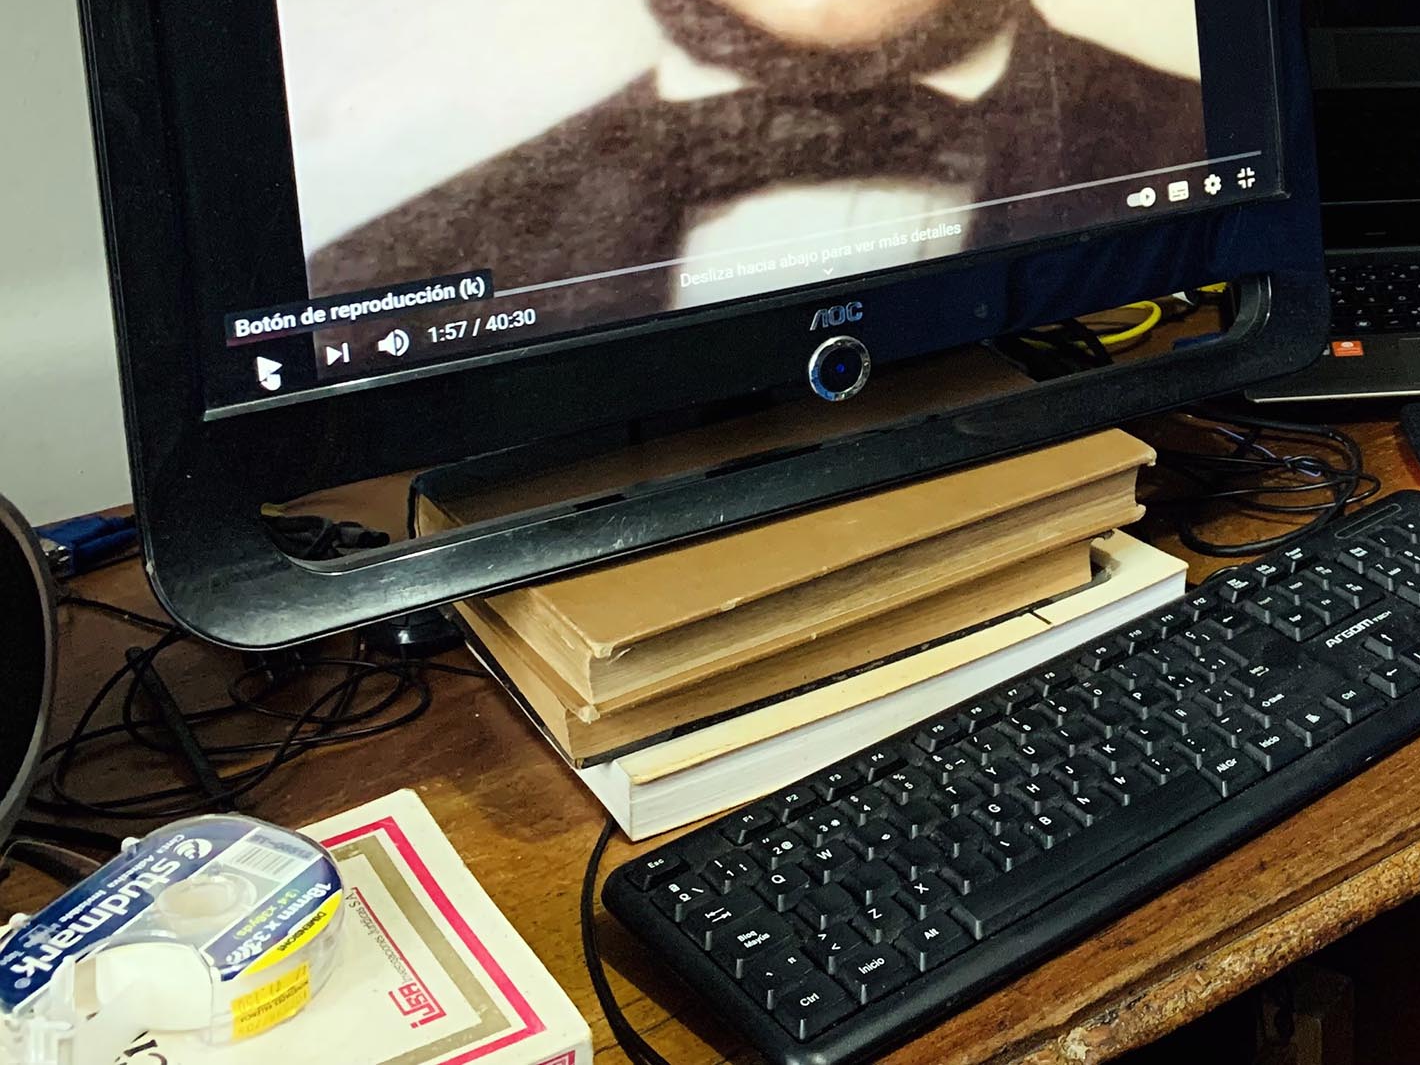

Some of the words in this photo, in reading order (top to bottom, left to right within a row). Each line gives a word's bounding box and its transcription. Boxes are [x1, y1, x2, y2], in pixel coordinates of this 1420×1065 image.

[680, 266, 734, 287] Desliza
[737, 259, 776, 275] hacia
[780, 251, 818, 270] abajo
[822, 244, 852, 264] para
[855, 241, 874, 256] ver
[879, 233, 907, 250] más
[911, 223, 961, 244] detalles
[235, 313, 295, 338] Botón
[301, 306, 326, 325] de
[331, 285, 455, 320] reproducción
[459, 276, 485, 300] (k)
[427, 320, 467, 343] 1:57
[485, 308, 536, 332] 40:30
[158, 834, 185, 854] Cinta
[647, 858, 665, 869] Esc
[816, 849, 833, 861] W
[107, 855, 155, 888] Adhesiva
[771, 874, 786, 884] Q
[914, 883, 930, 894] X
[277, 882, 332, 921] 18mm
[10, 857, 181, 978] studmark
[867, 908, 882, 920] Z
[923, 927, 940, 941] Alt
[857, 957, 886, 975] Inicio
[799, 992, 820, 1007] Ctrl
